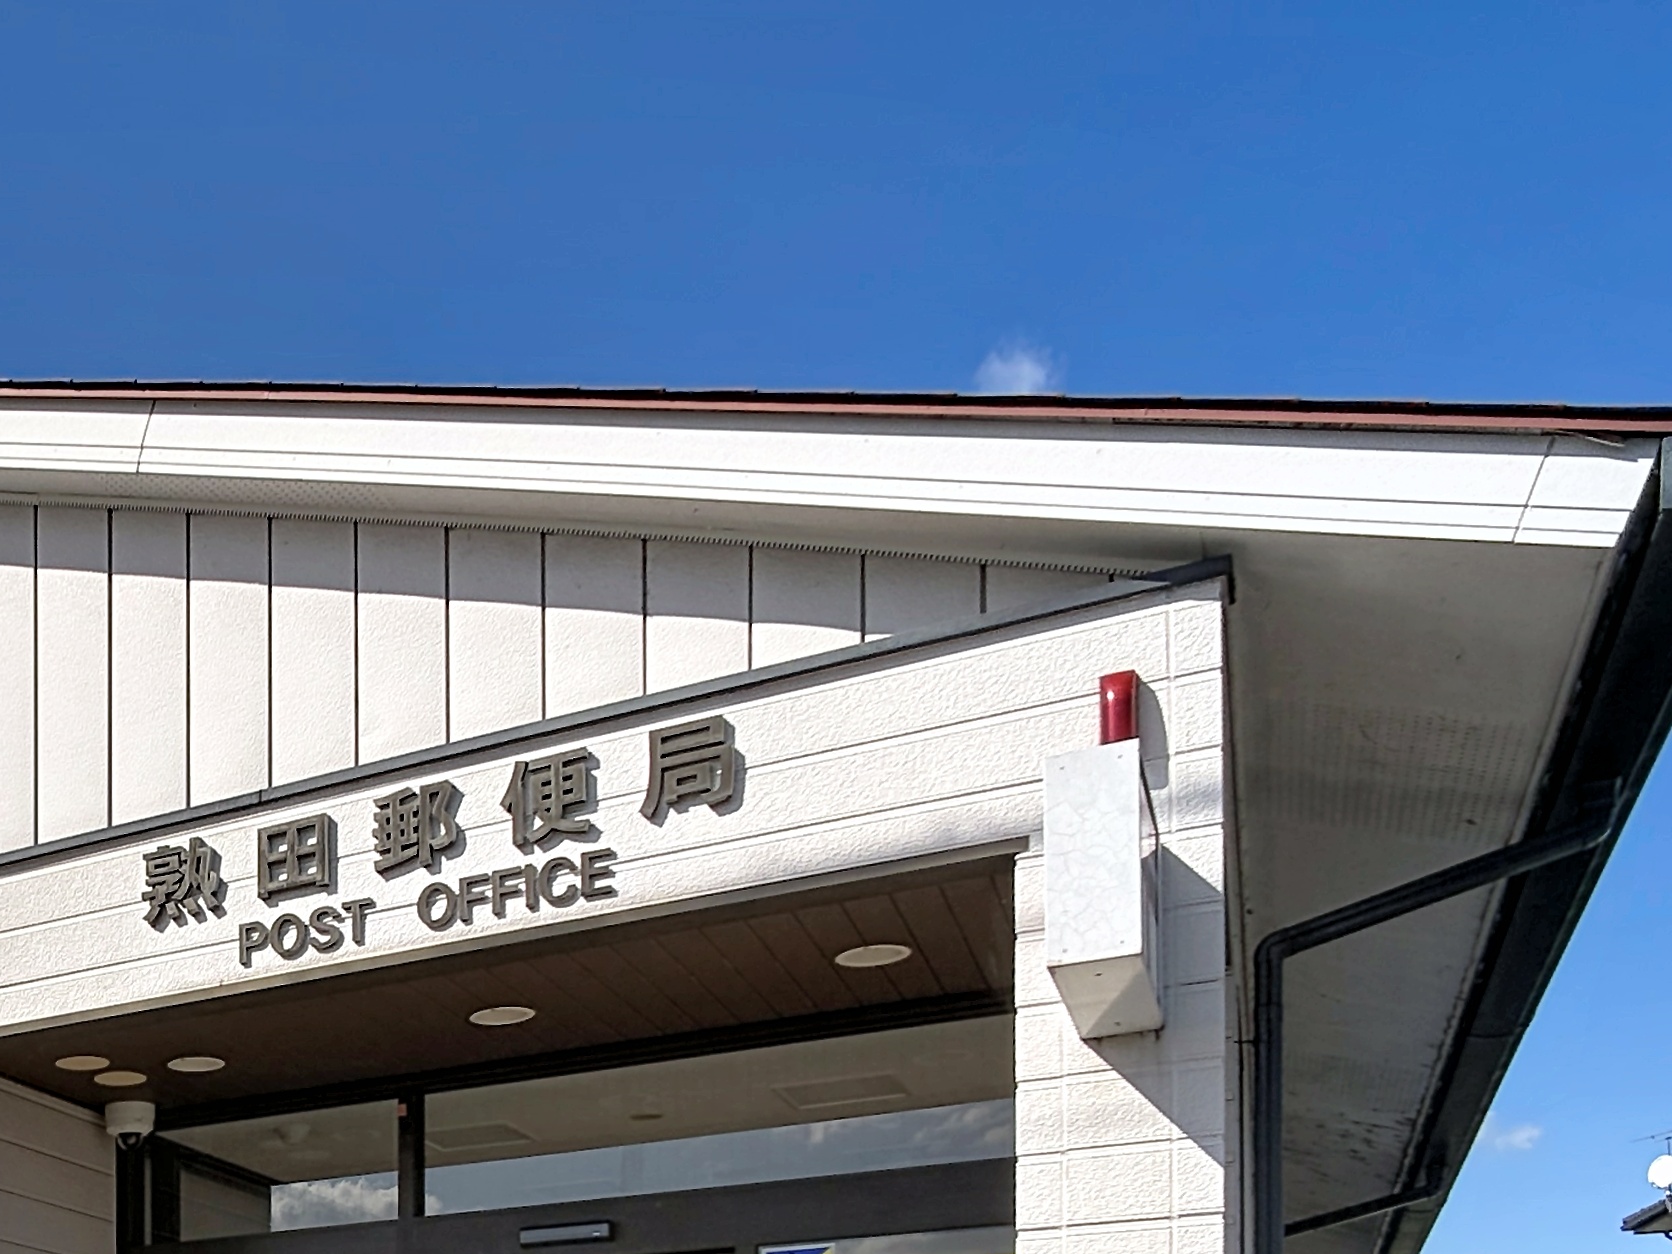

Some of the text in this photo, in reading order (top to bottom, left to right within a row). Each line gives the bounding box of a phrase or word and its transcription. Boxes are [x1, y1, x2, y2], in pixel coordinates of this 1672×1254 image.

[140, 715, 740, 932] 熟田郵便局
[238, 847, 618, 967] POST OFFICE
